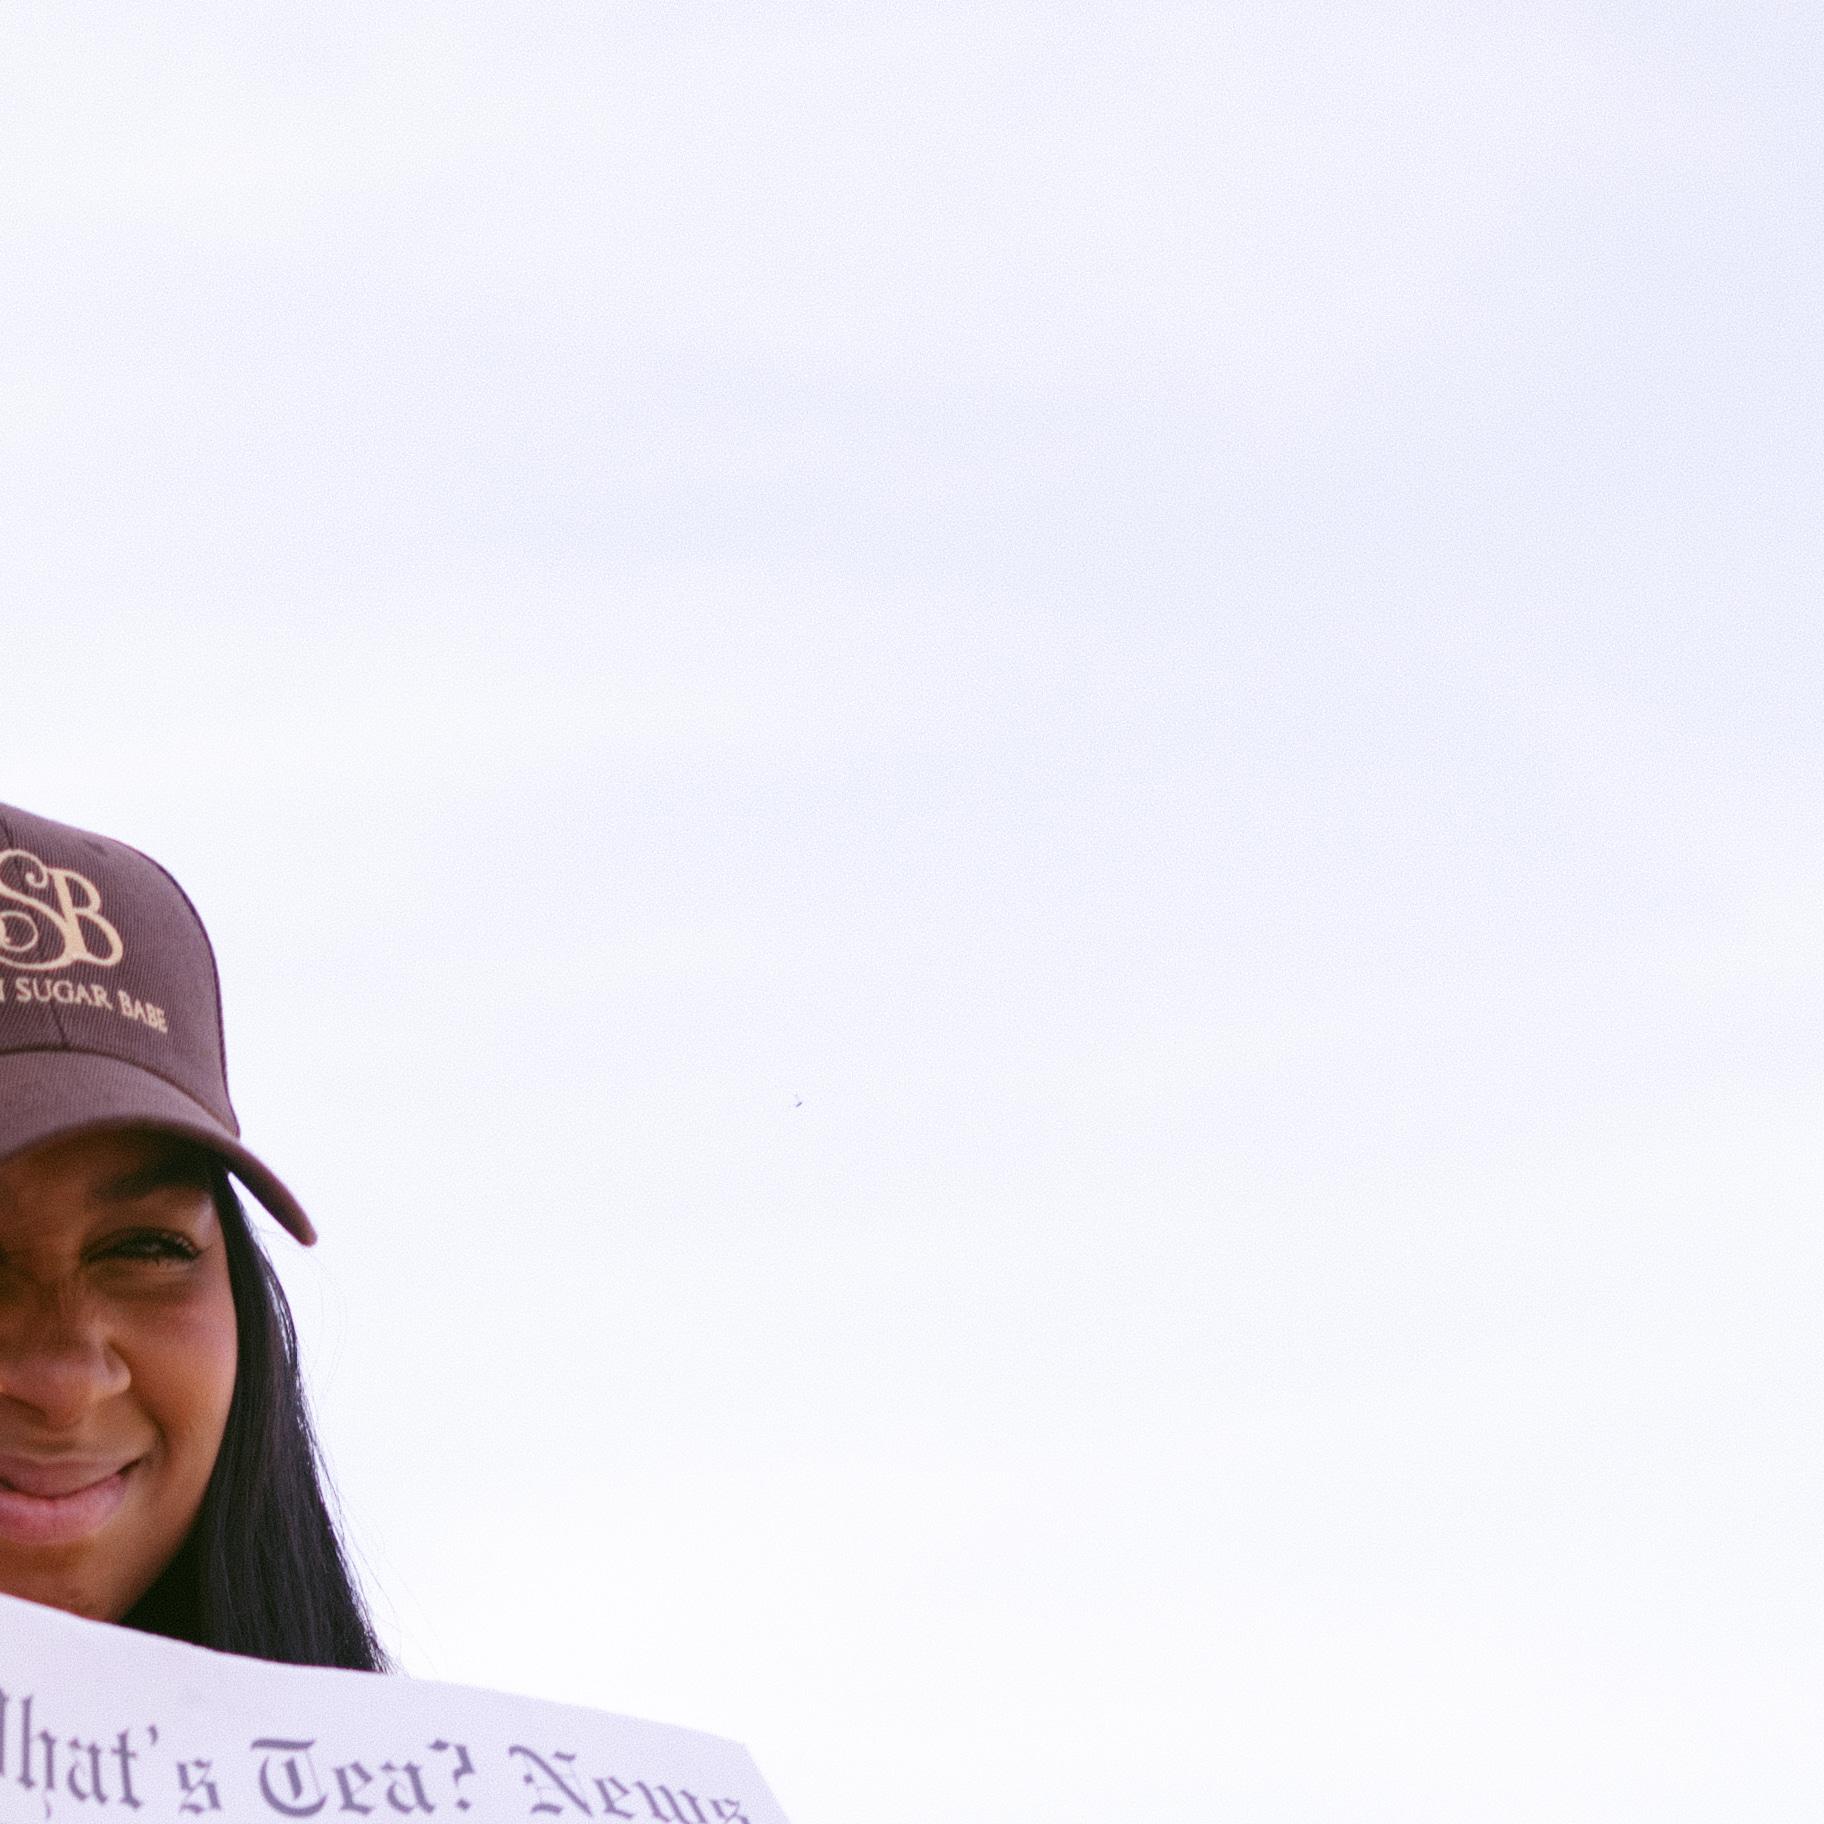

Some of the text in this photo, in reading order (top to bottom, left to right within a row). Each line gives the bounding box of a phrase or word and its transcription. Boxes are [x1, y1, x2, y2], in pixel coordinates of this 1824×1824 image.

[15, 977, 113, 1010] SUGAR
[118, 989, 168, 1033] BABE
[250, 1738, 476, 1820] Tea?
